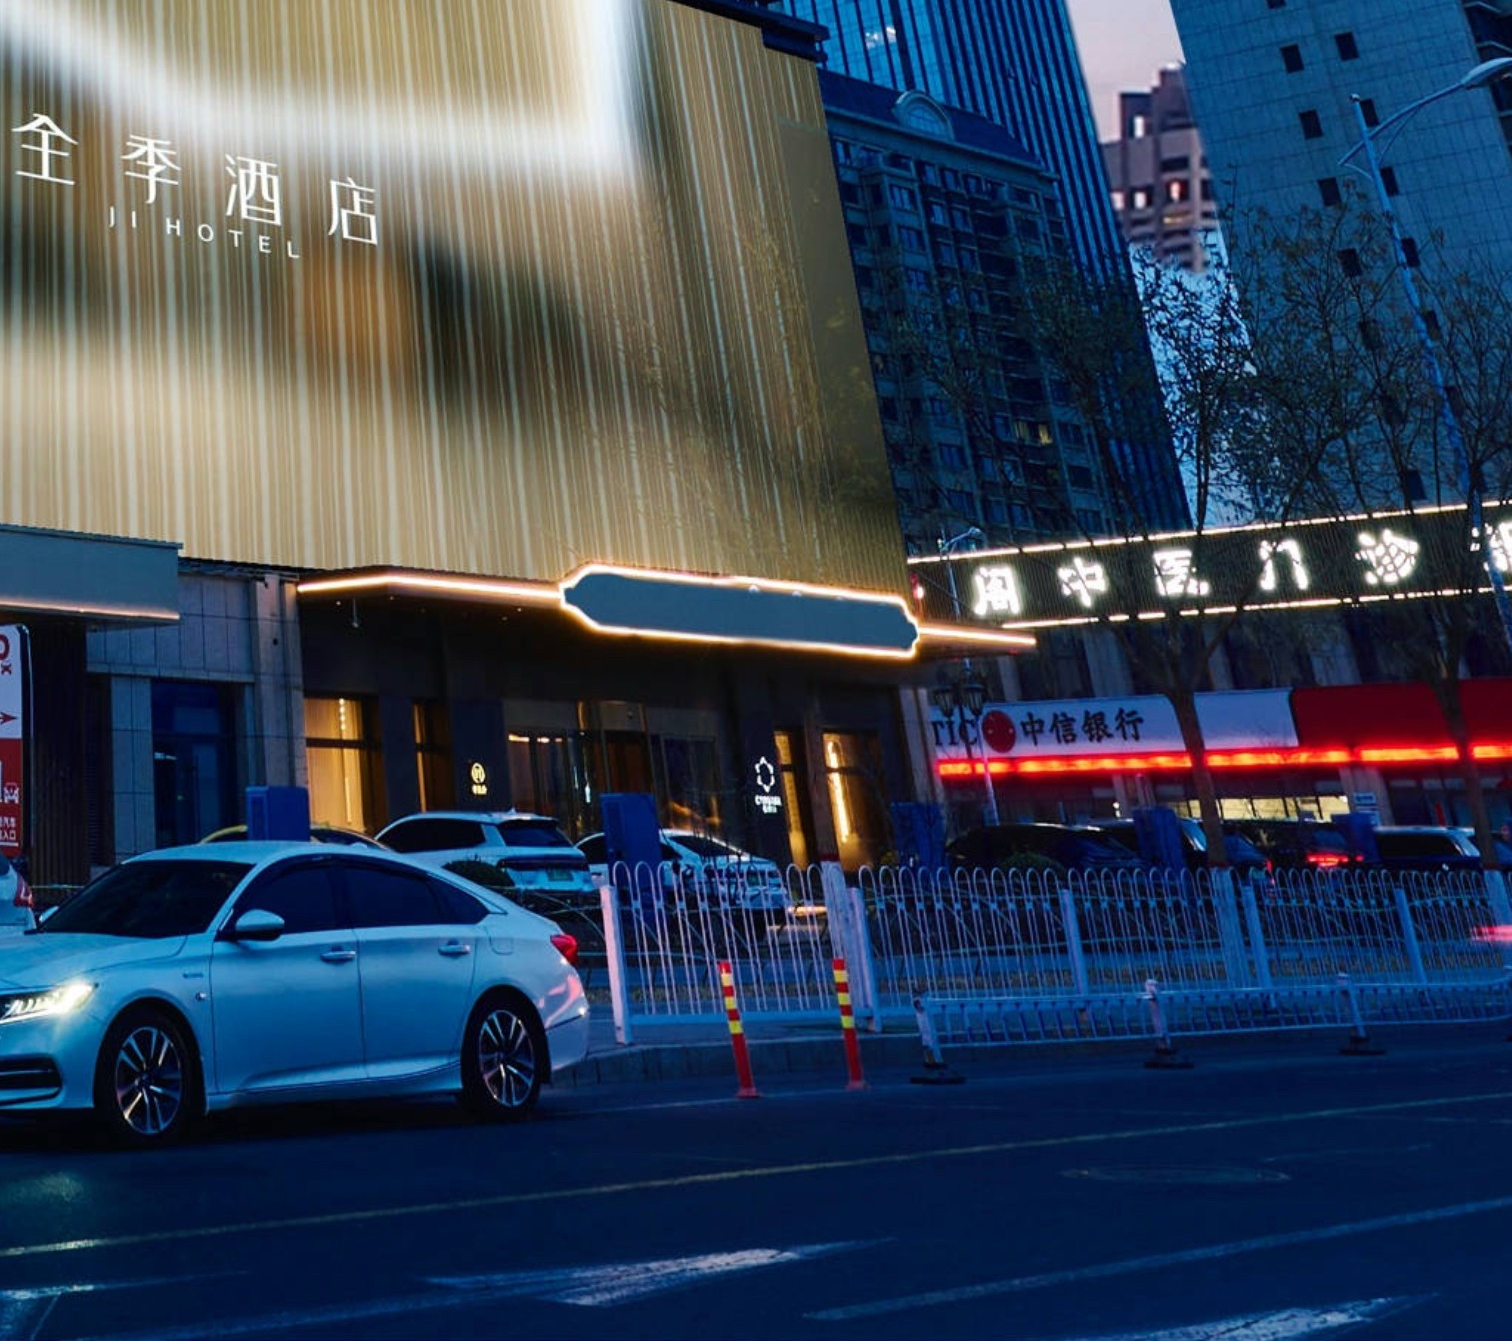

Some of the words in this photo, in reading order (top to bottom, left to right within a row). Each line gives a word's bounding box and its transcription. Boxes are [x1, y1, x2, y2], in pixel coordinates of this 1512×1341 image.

[12, 113, 377, 245] 全季酒店
[109, 206, 136, 228] JI
[166, 218, 300, 259] HOTEL
[1020, 707, 1144, 746] 中信银行
